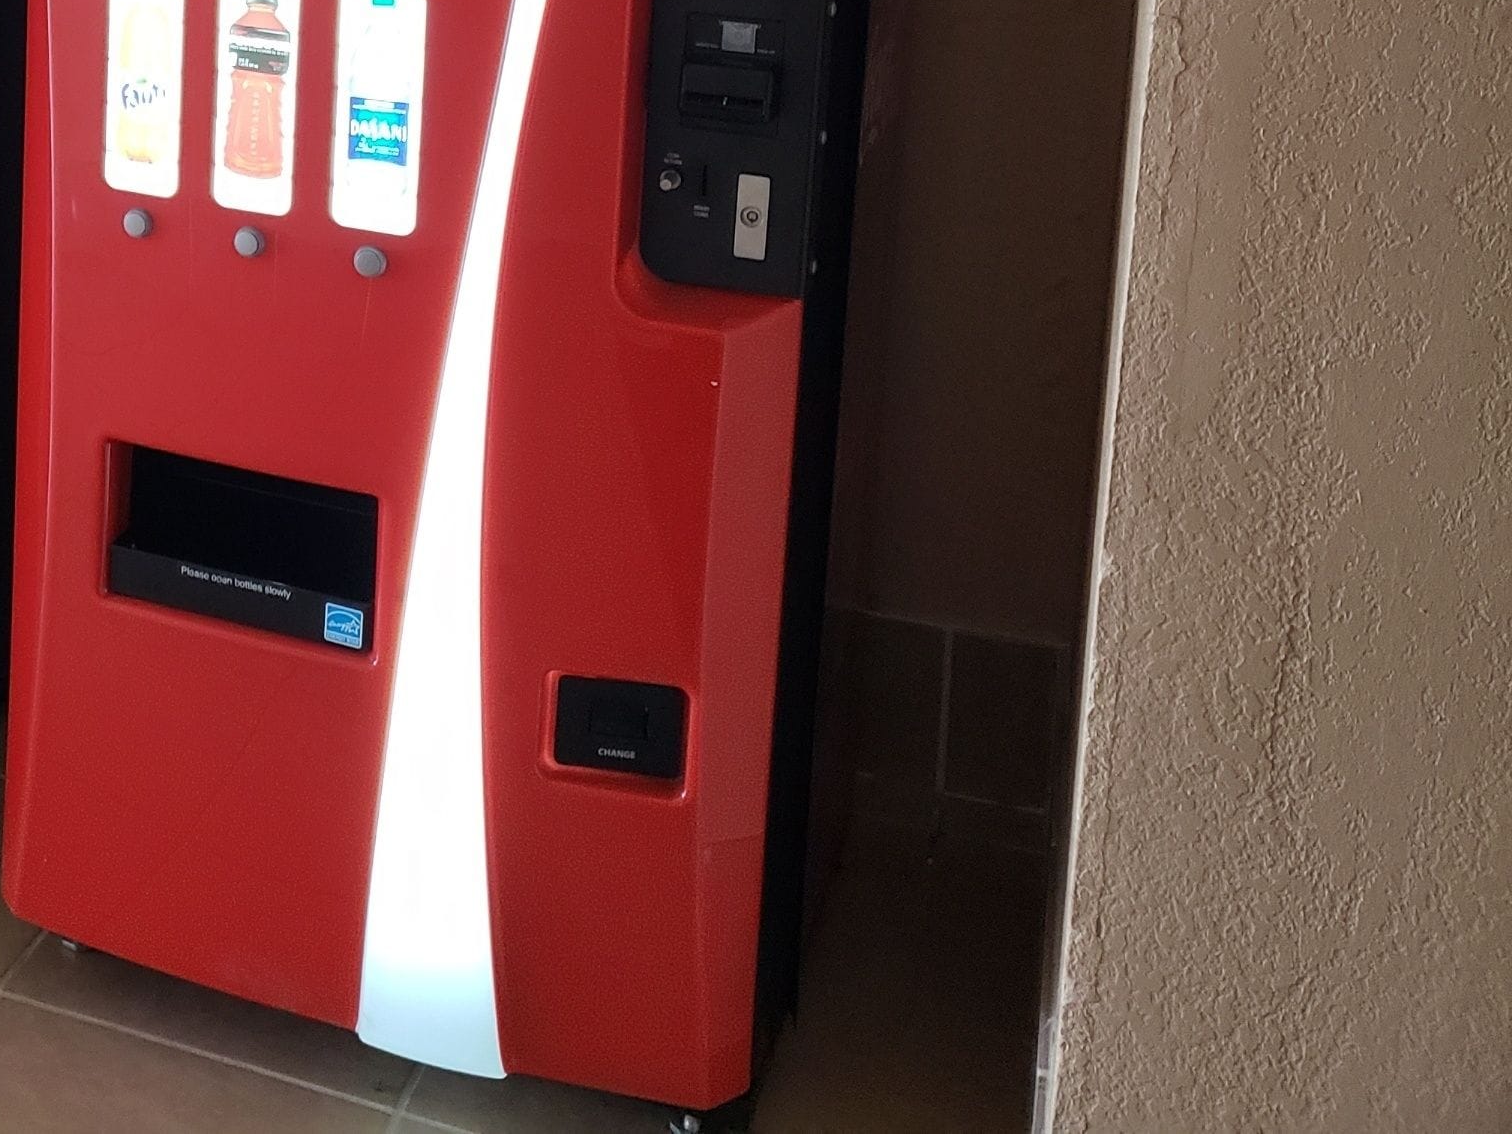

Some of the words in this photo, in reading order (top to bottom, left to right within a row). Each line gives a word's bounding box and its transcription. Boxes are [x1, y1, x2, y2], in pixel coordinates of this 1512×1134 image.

[180, 565, 209, 581] Please
[234, 577, 263, 593] bottles
[264, 584, 292, 601] slowly
[597, 747, 636, 759] CHANGE
